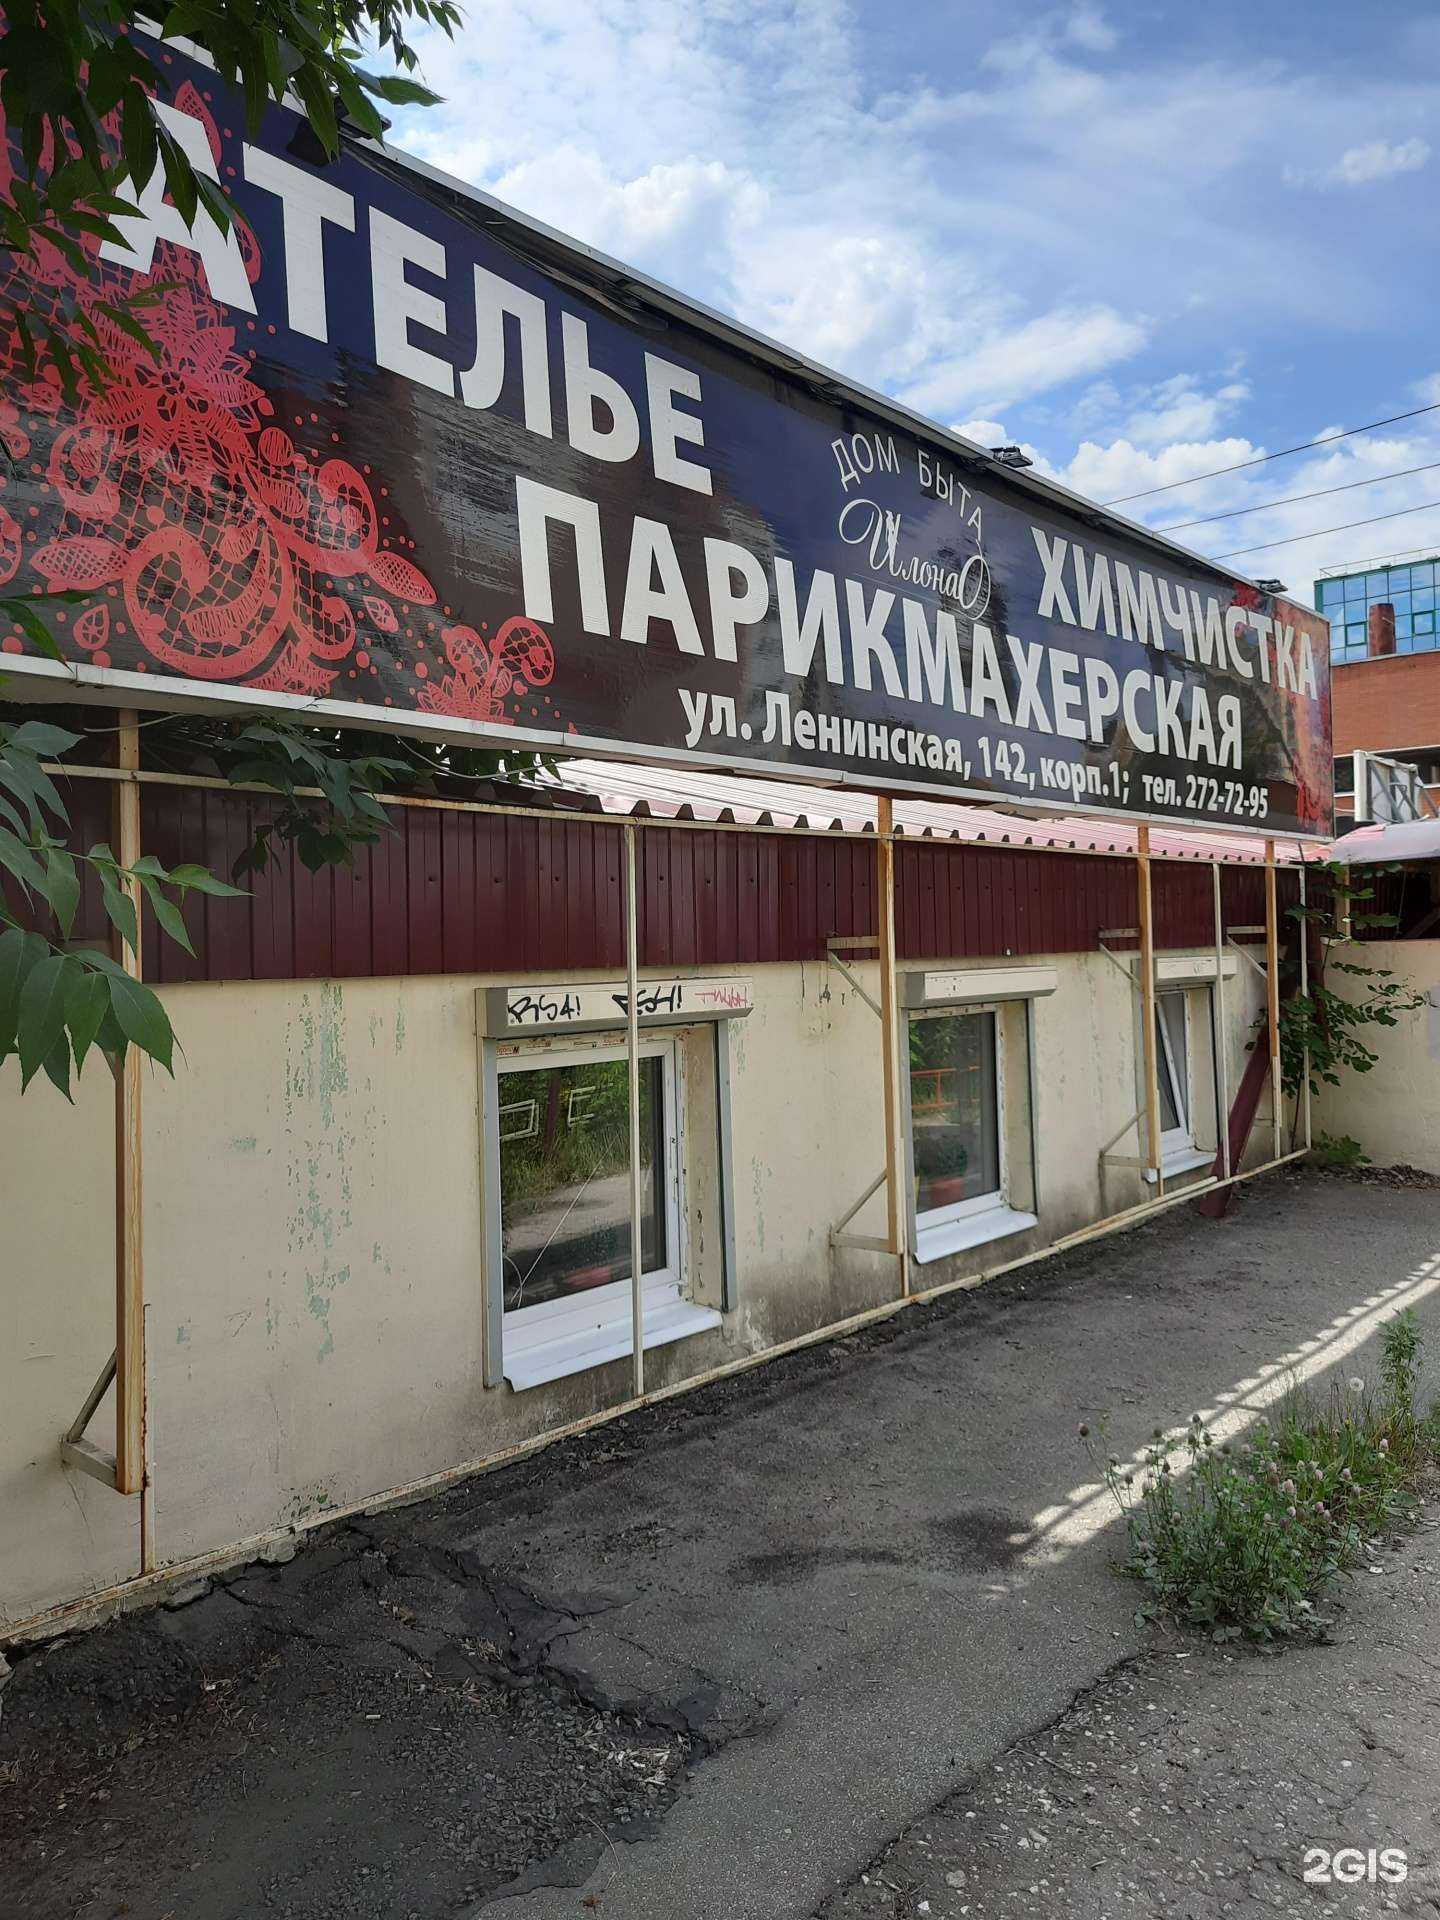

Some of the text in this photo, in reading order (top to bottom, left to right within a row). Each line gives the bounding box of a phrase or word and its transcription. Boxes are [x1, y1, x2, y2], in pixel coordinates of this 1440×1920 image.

[99, 96, 713, 497] АТЕЛЬЕ
[831, 433, 983, 542] ДОМ БЫТА
[515, 475, 1243, 770] ПАРИКМАХЕРСКАЯ
[1030, 525, 1319, 701] ХИМЧИСТКА
[677, 687, 753, 750] ул.
[761, 689, 972, 782] Ленинская,
[977, 735, 1036, 792] 142,
[1141, 773, 1183, 808] тел.
[1184, 774, 1269, 820] 272-72-95
